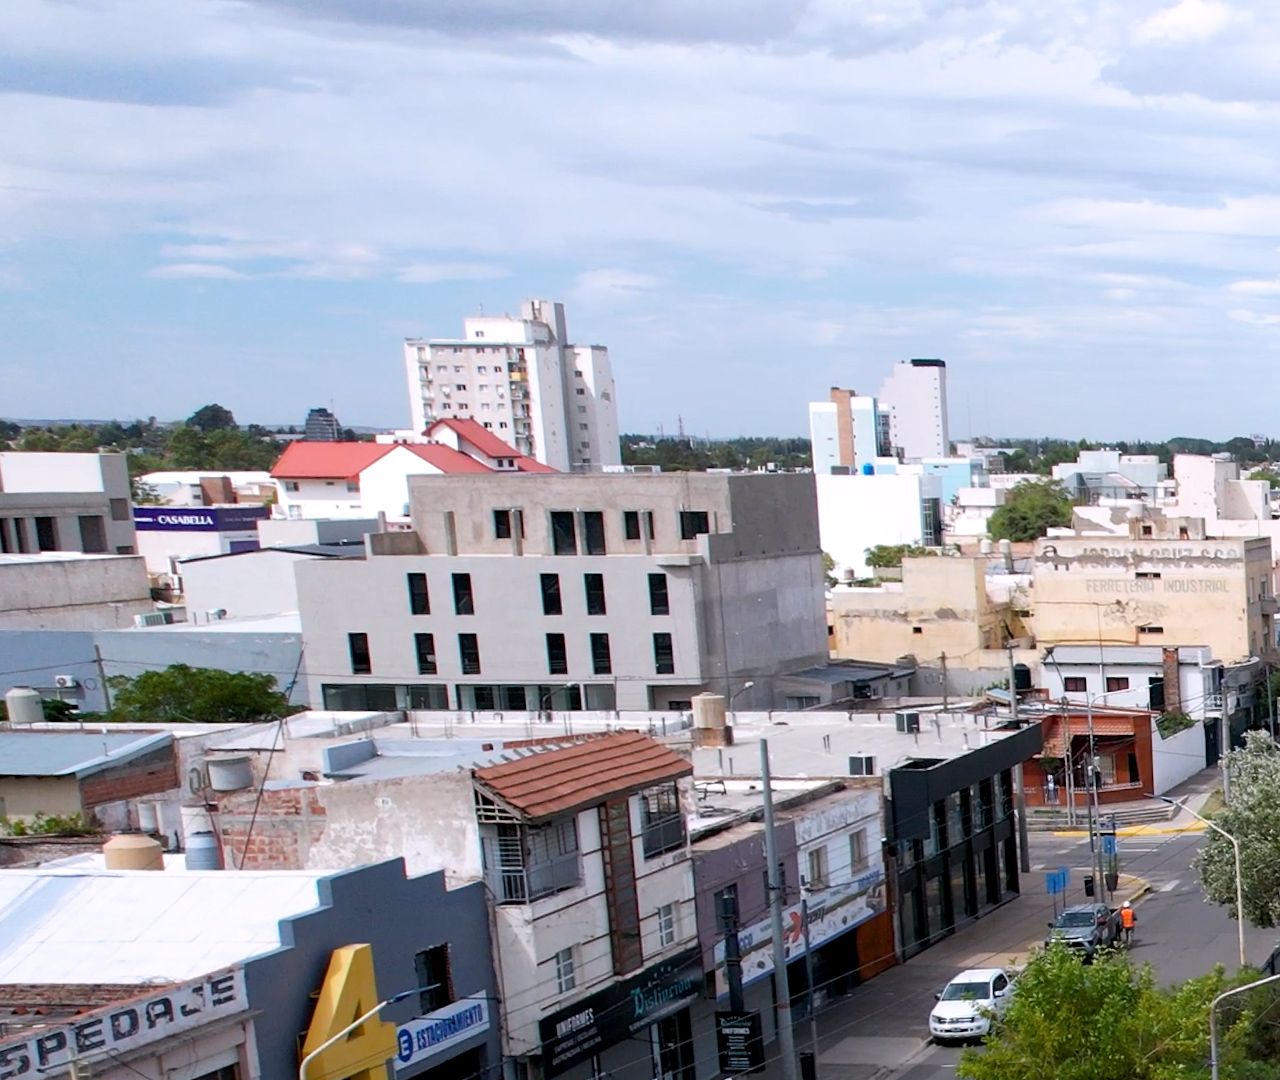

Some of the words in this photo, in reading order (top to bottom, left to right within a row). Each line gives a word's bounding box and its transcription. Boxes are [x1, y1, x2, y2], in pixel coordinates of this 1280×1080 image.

[157, 515, 214, 525] CASABELLA
[1164, 580, 1229, 593] INDUSTRIAL
[416, 1003, 483, 1050] ESTACIONAMIENTO
